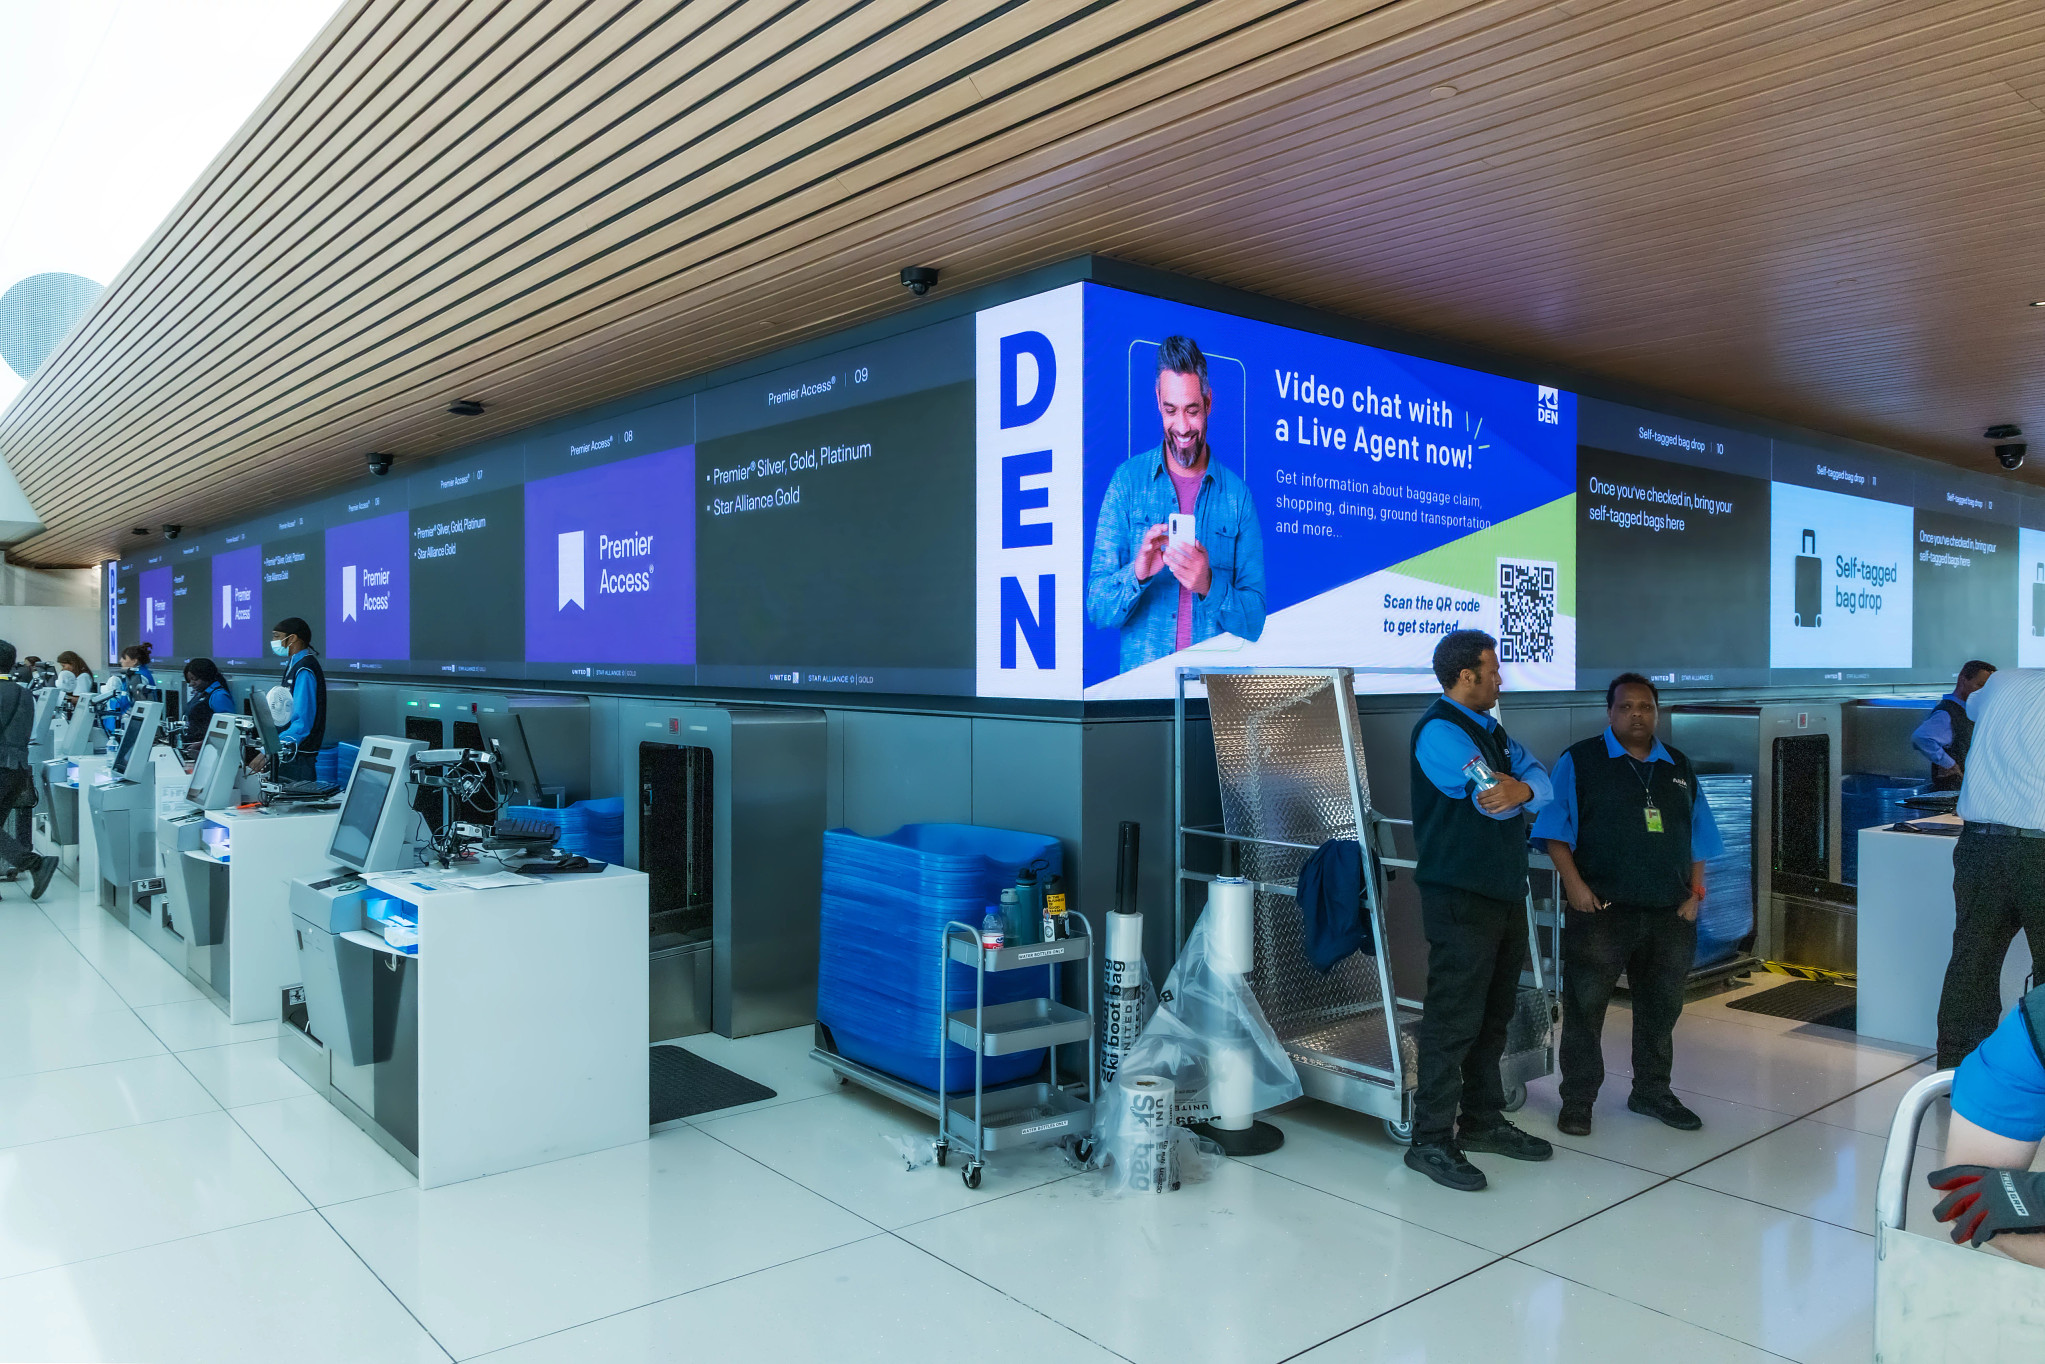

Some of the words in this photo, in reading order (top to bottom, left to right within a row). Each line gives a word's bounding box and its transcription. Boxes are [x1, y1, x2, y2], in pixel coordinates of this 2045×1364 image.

[768, 388, 799, 406] Premier
[855, 368, 869, 384] 09
[1275, 369, 1345, 409] Video
[1352, 386, 1402, 420] chat
[1408, 398, 1453, 429] with
[1538, 408, 1558, 425] DEN
[570, 444, 590, 456] Premier
[624, 430, 633, 443] 08
[1275, 418, 1289, 442] a
[1298, 416, 1347, 450] Live
[1354, 426, 1419, 462] Agent
[1426, 444, 1472, 470] now!
[1638, 426, 1677, 447] Self-tagged
[1678, 435, 1690, 451] bag
[1691, 438, 1705, 453] drop
[1716, 443, 1724, 455] 10
[757, 458, 788, 478] Silver,
[789, 448, 818, 471] Gold,
[820, 442, 872, 466] Platinum
[1276, 469, 1297, 486] Get
[1301, 472, 1369, 494] information
[1372, 482, 1403, 498] about
[1406, 486, 1451, 506] baggage
[1453, 493, 1483, 510] claim,
[1816, 464, 1844, 481] Self-tagged
[1845, 470, 1854, 484] bag
[1854, 472, 1864, 486] drop
[714, 497, 733, 516] Star
[734, 492, 774, 513] Alliance
[775, 485, 800, 506] Gold
[1000, 330, 1056, 670] DEN
[1589, 477, 1616, 496] Once
[1617, 485, 1646, 501] you've
[1647, 486, 1683, 506] checked
[1684, 492, 1693, 510] in,
[1694, 493, 1715, 515] bring
[1715, 500, 1733, 515] your
[464, 518, 486, 530] Platinum
[1276, 494, 1335, 516] shopping,
[1338, 501, 1377, 520] dining,
[1380, 508, 1418, 521] ground
[1421, 510, 1491, 530] transportation
[1589, 505, 1642, 528] self-tagged
[1643, 511, 1664, 532] bags
[1666, 514, 1685, 531] here
[1276, 520, 1299, 534] and
[1920, 530, 1934, 543] Once
[445, 542, 457, 556] Gold
[599, 531, 654, 560] Premier
[1919, 550, 1948, 567] self-tagged
[364, 567, 390, 587] Premier
[1836, 555, 1897, 588] Self-tagged
[1384, 594, 1413, 610] Scan
[1416, 595, 1434, 611] the
[1436, 597, 1452, 612] QR
[1455, 598, 1480, 612] code
[1836, 585, 1856, 614] bag
[1858, 588, 1882, 616] drop
[1384, 618, 1395, 633] to
[1398, 619, 1417, 636] get
[808, 674, 822, 682] STAR
[822, 675, 849, 683] ALLIANCE
[859, 676, 874, 684] GOLD
[1110, 960, 1126, 996] bag
[1108, 1002, 1120, 1046] boot
[1123, 1004, 1132, 1057] NITED
[1106, 1054, 1119, 1083] Ski
[1156, 1098, 1164, 1162] UNITED
[1130, 1144, 1154, 1191] bag
[2010, 1193, 2027, 1215] GRIP
